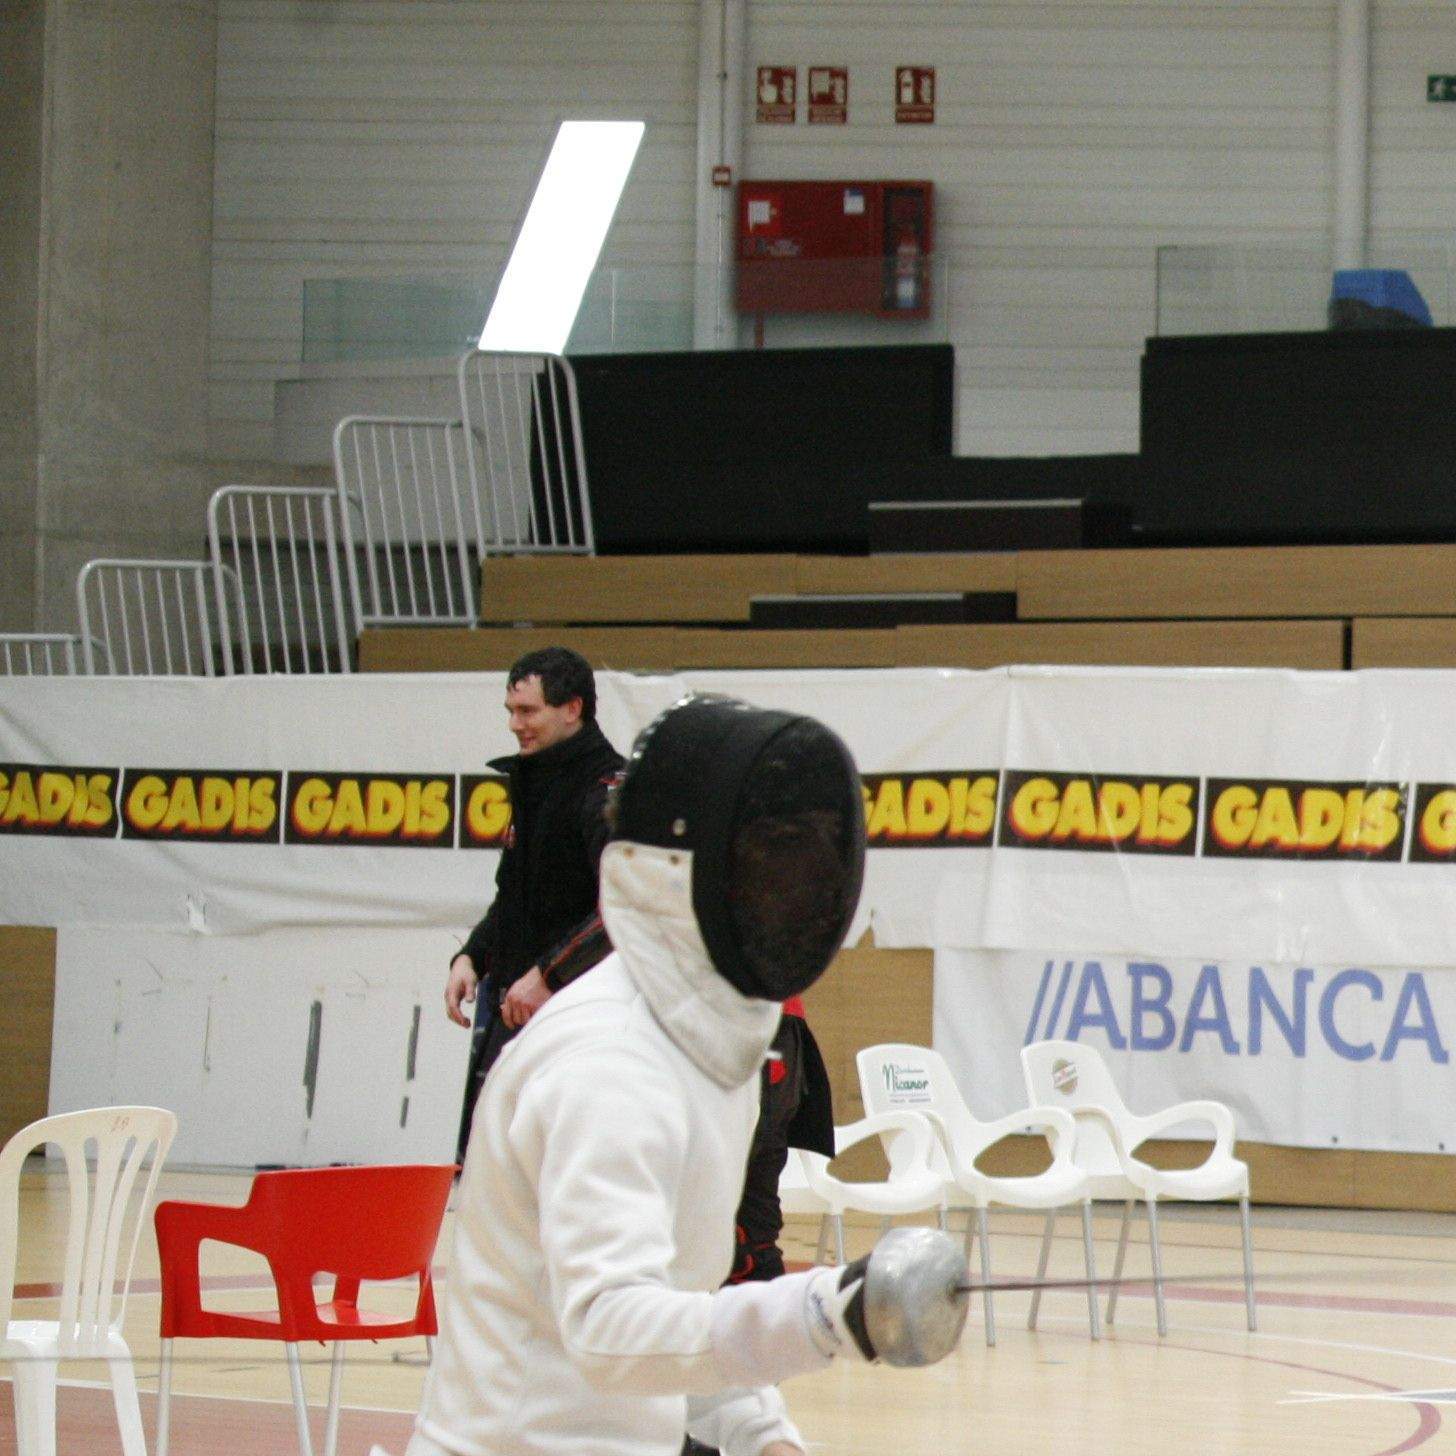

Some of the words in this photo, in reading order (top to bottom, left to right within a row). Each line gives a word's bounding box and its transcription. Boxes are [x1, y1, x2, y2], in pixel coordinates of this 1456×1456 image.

[0, 771, 114, 830] ADIS
[127, 774, 277, 836] GADIS
[292, 777, 450, 839] GADIS
[862, 777, 999, 840] ADIS
[1008, 777, 1194, 845] GADIS
[1211, 785, 1401, 854] GADIS
[1064, 960, 1450, 1064] ABANCA
